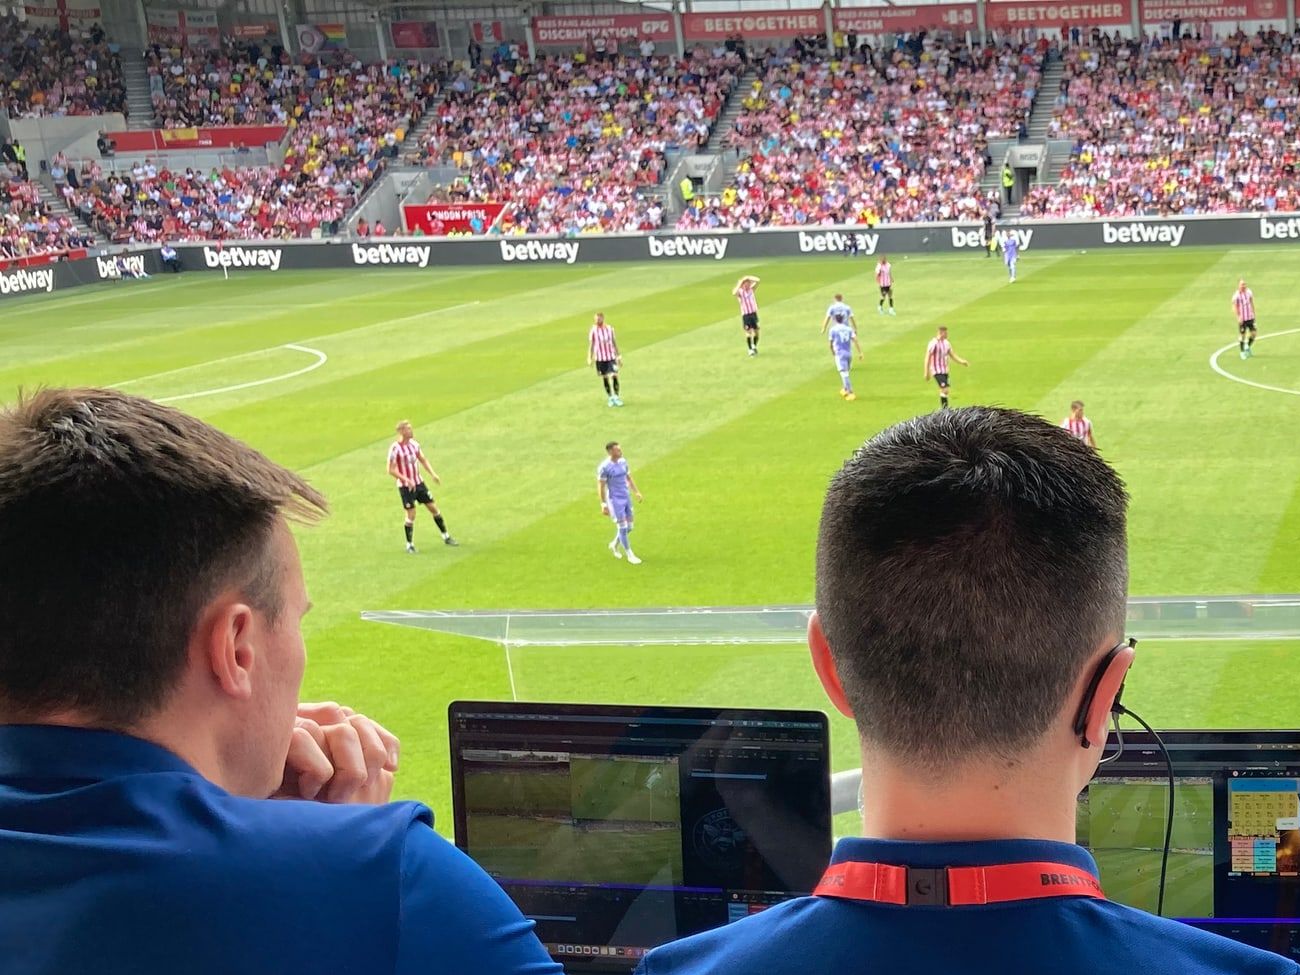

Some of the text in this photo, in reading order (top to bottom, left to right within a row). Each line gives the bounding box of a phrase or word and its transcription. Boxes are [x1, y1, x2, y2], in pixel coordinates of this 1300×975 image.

[704, 15, 818, 32] BEETOGETHER
[1006, 4, 1123, 22] BEETOGETHER
[1144, 6, 1248, 20] DISCRIMINATION
[838, 19, 884, 31] RACISM
[1102, 223, 1185, 246] betway
[204, 246, 282, 271] betway
[352, 243, 430, 267] betway
[500, 240, 579, 263] betway
[648, 236, 728, 259] betway
[0, 269, 54, 294] betway
